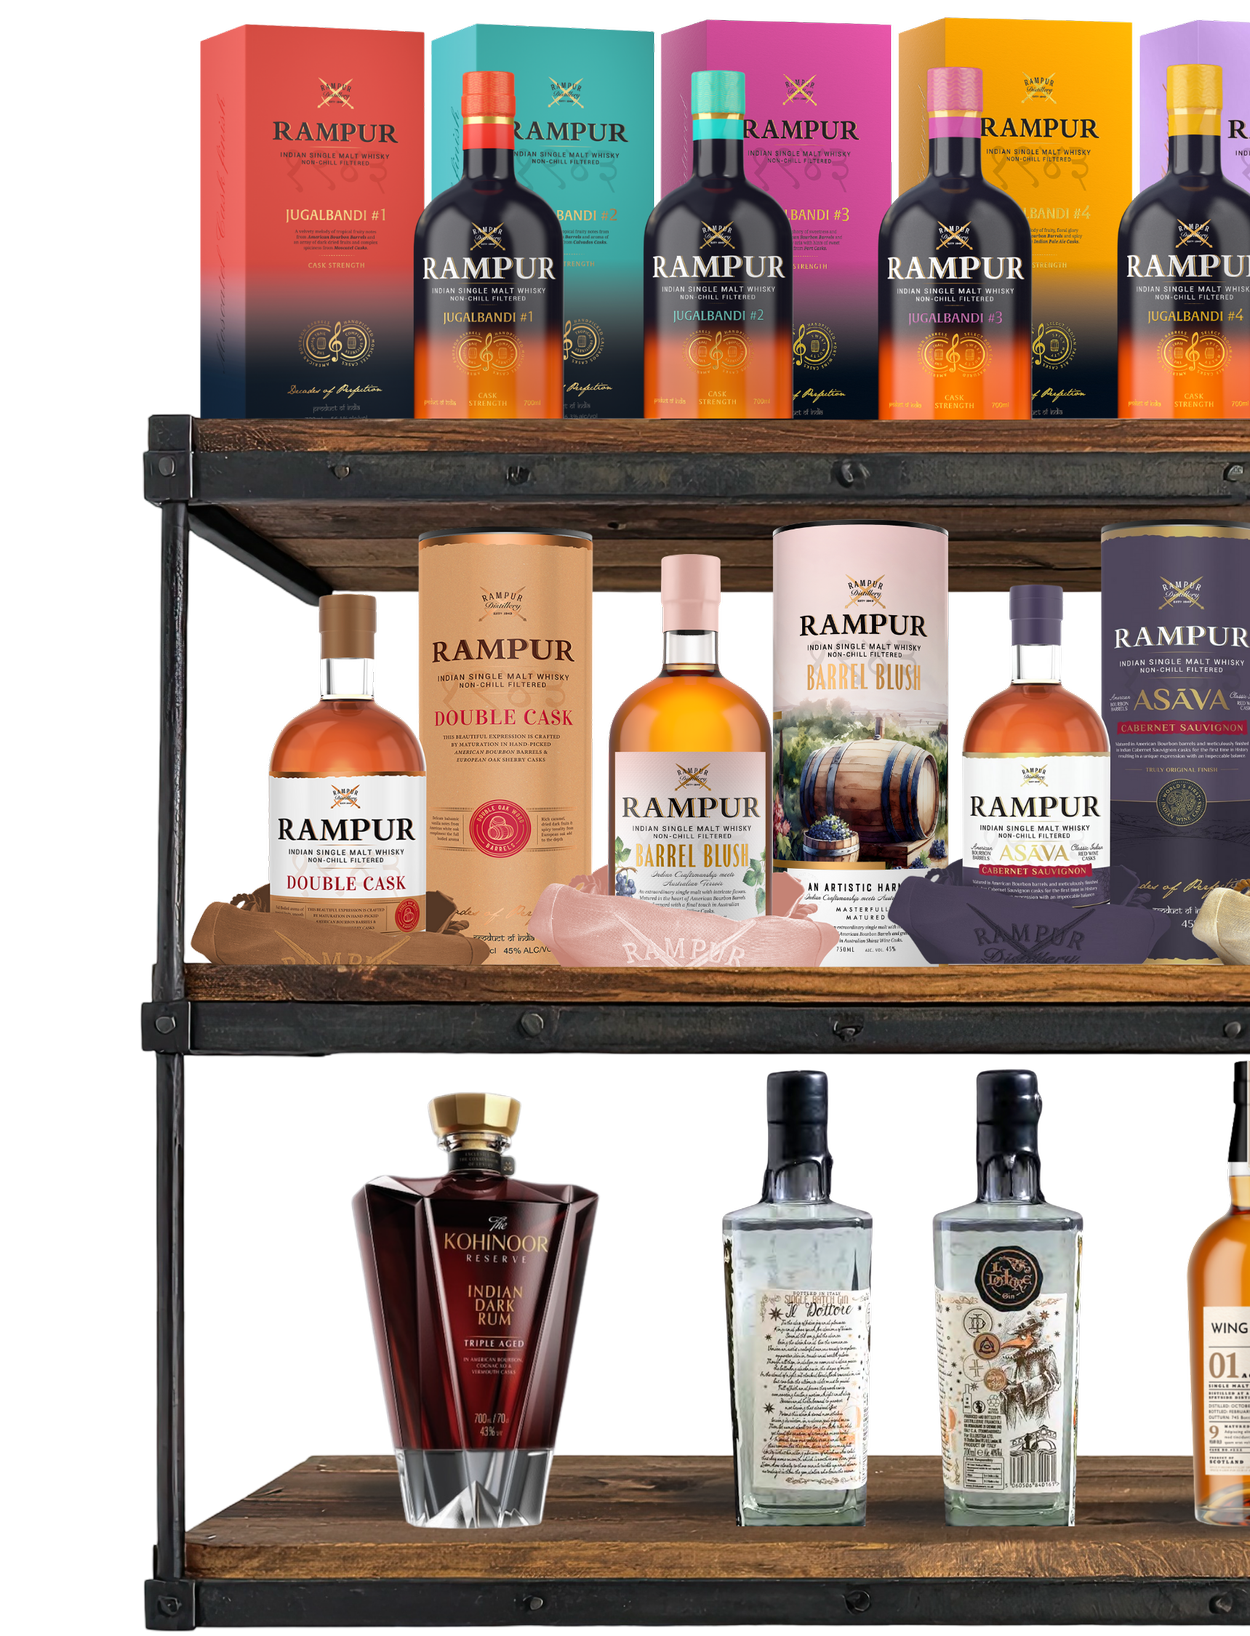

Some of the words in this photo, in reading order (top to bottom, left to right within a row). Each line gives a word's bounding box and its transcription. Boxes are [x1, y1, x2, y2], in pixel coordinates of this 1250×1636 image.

[273, 121, 398, 143] RAMPUR
[744, 119, 860, 140] RAMPUR
[981, 117, 1100, 139] RAMPUR
[286, 209, 367, 223] JUGALBANDI
[371, 208, 386, 221] #1
[422, 257, 556, 280] RAMPUR
[652, 256, 786, 278] RAMPUR
[887, 256, 1025, 280] RAMPUR
[443, 312, 516, 325] JUGALBANDI
[520, 311, 533, 322] #1
[673, 310, 746, 323] JUGALBANDI
[750, 309, 764, 321] #2
[908, 312, 983, 325] JUGALBANDI
[988, 311, 1003, 324] #3
[1148, 311, 1223, 323] JUGALBANDI
[1228, 308, 1243, 321] #4
[287, 384, 321, 395] Decades
[323, 386, 335, 399] of
[336, 383, 383, 399] Perfection
[800, 614, 928, 637] RAMPUR
[1114, 625, 1250, 649] RAMPUR
[432, 638, 575, 663] RAMPUR
[437, 674, 465, 682] INDIAN
[537, 673, 569, 681] WHISKY
[807, 663, 868, 690] BARREL
[876, 663, 921, 690] BLUSH
[435, 709, 516, 726] DOUBLE
[524, 709, 573, 726] CASK
[1121, 724, 1176, 732] CABERNET
[1180, 724, 1243, 732] SAUVIGNON
[622, 797, 761, 819] RAMPUR
[970, 796, 1101, 817] RAMPUR
[278, 818, 416, 841] RAMPUR
[635, 844, 696, 868] BARREL
[704, 843, 749, 868] BLUSH
[981, 867, 1028, 875] CABERNET
[1032, 867, 1086, 875] SAUVIGNON
[287, 875, 357, 891] DOUBLE
[363, 875, 406, 891] CASK
[808, 882, 819, 891] AN
[824, 883, 872, 892] ARTISTIC
[488, 1216, 508, 1232] The
[444, 1233, 549, 1252] KOHINOOR
[466, 1254, 527, 1264] RESERVE
[468, 1285, 523, 1298] INDIAN
[475, 1299, 515, 1312] DARK
[478, 1313, 511, 1325] RUM
[1211, 1322, 1248, 1334] WING
[463, 1339, 495, 1348] TRIPLE
[499, 1339, 525, 1348] AGED
[1209, 1352, 1239, 1379] 01
